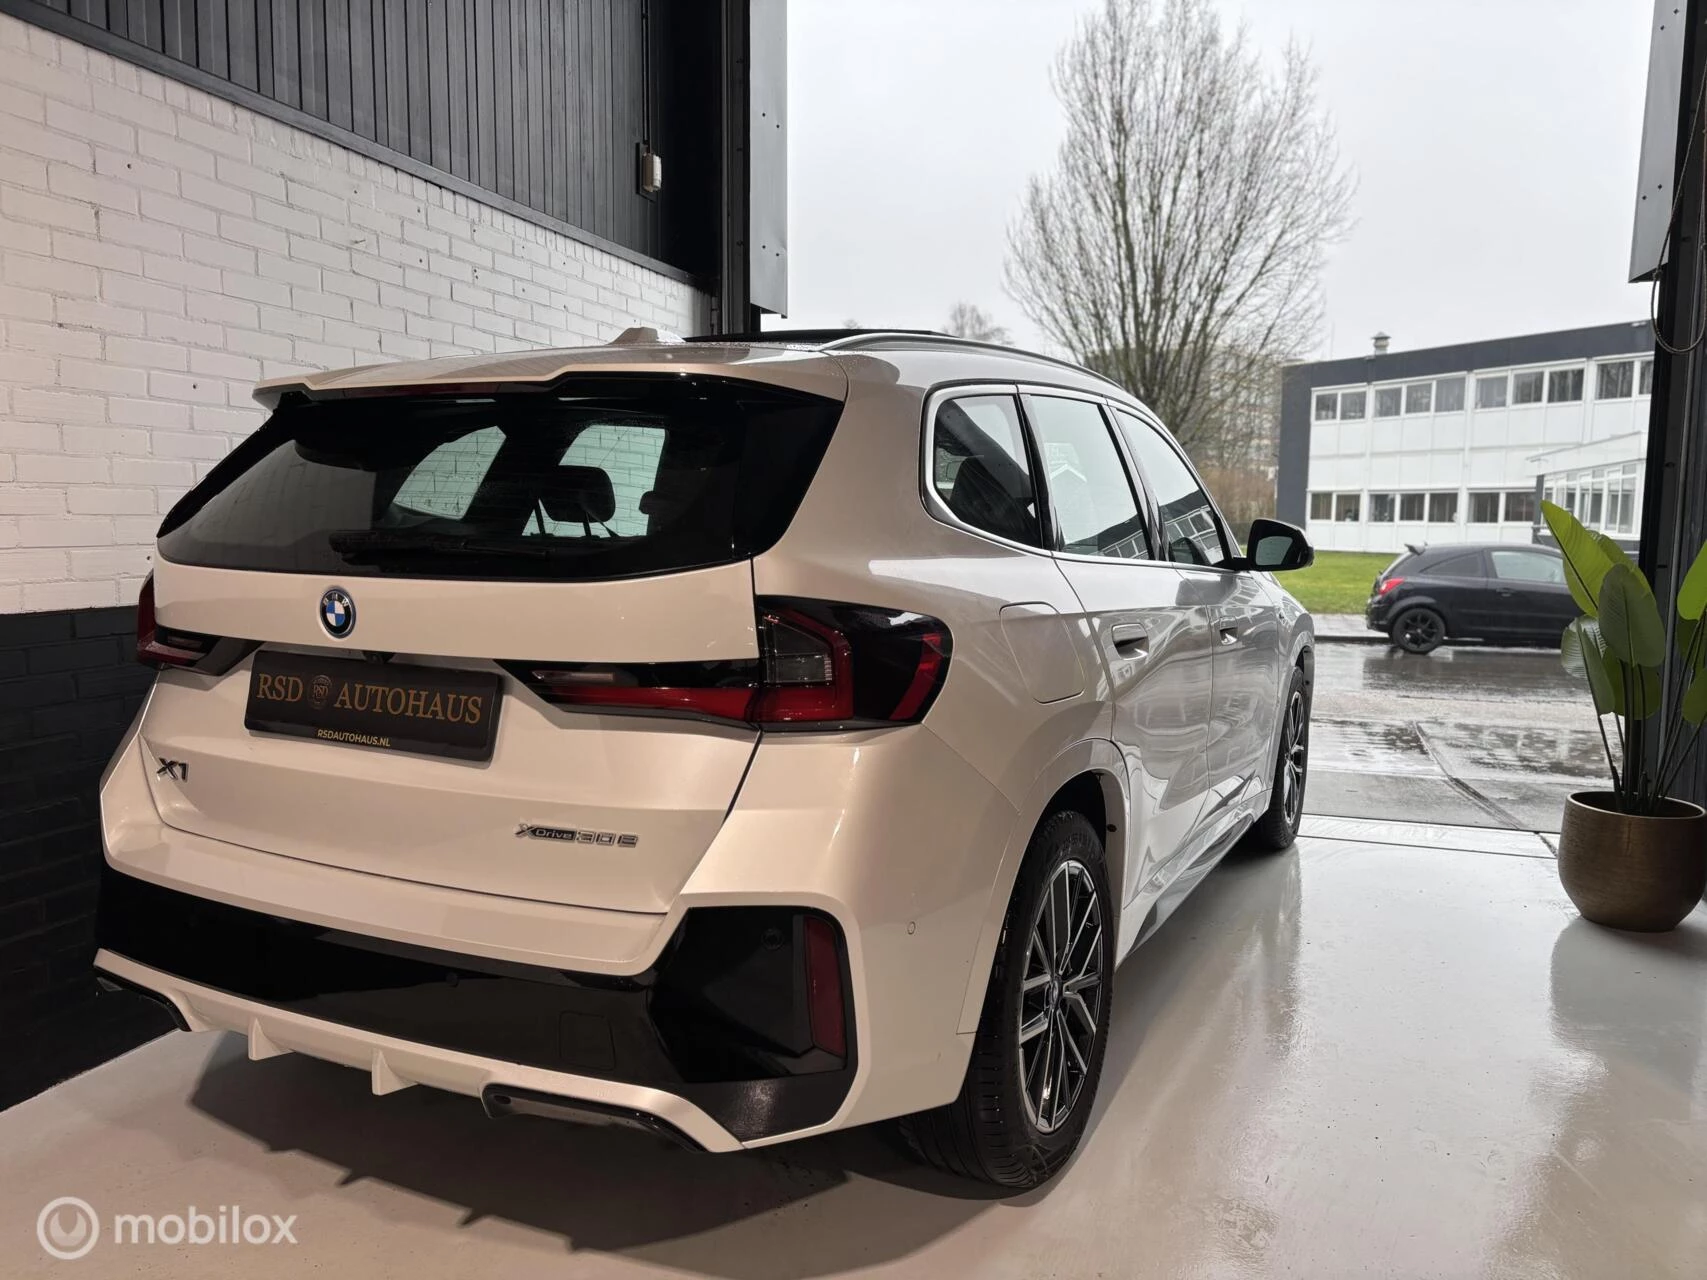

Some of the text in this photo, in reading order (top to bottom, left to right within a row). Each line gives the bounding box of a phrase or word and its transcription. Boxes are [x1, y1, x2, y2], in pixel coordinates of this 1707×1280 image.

[322, 593, 350, 607] BMW
[257, 673, 304, 702] RSD
[333, 683, 482, 724] AUTOHAUS
[317, 729, 391, 747] RSDAUTOHAUS.NL
[157, 757, 188, 782] X1
